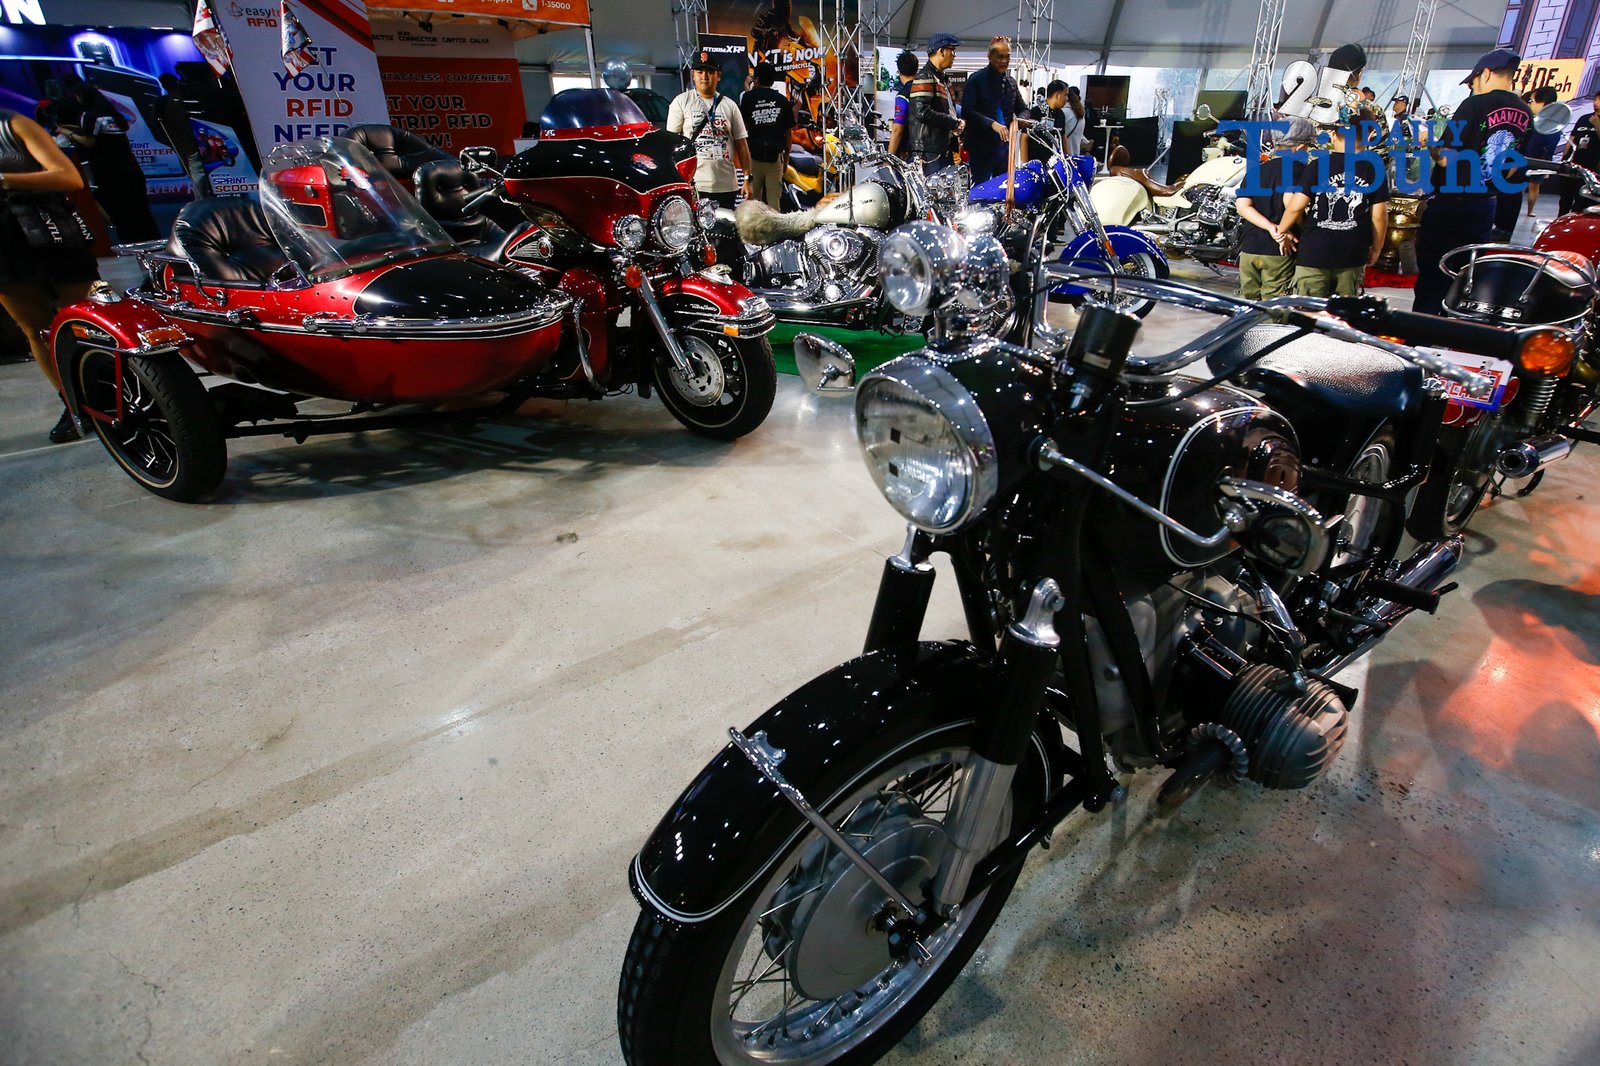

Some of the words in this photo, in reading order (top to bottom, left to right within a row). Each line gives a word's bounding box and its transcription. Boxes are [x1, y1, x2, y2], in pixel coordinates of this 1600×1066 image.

[247, 18, 277, 28] RFID
[782, 49, 793, 63] is
[272, 72, 356, 92] YOUR
[286, 98, 354, 118] RFID
[406, 94, 467, 111] YOUR
[445, 112, 493, 129] RFID
[1488, 110, 1529, 128] MANILA
